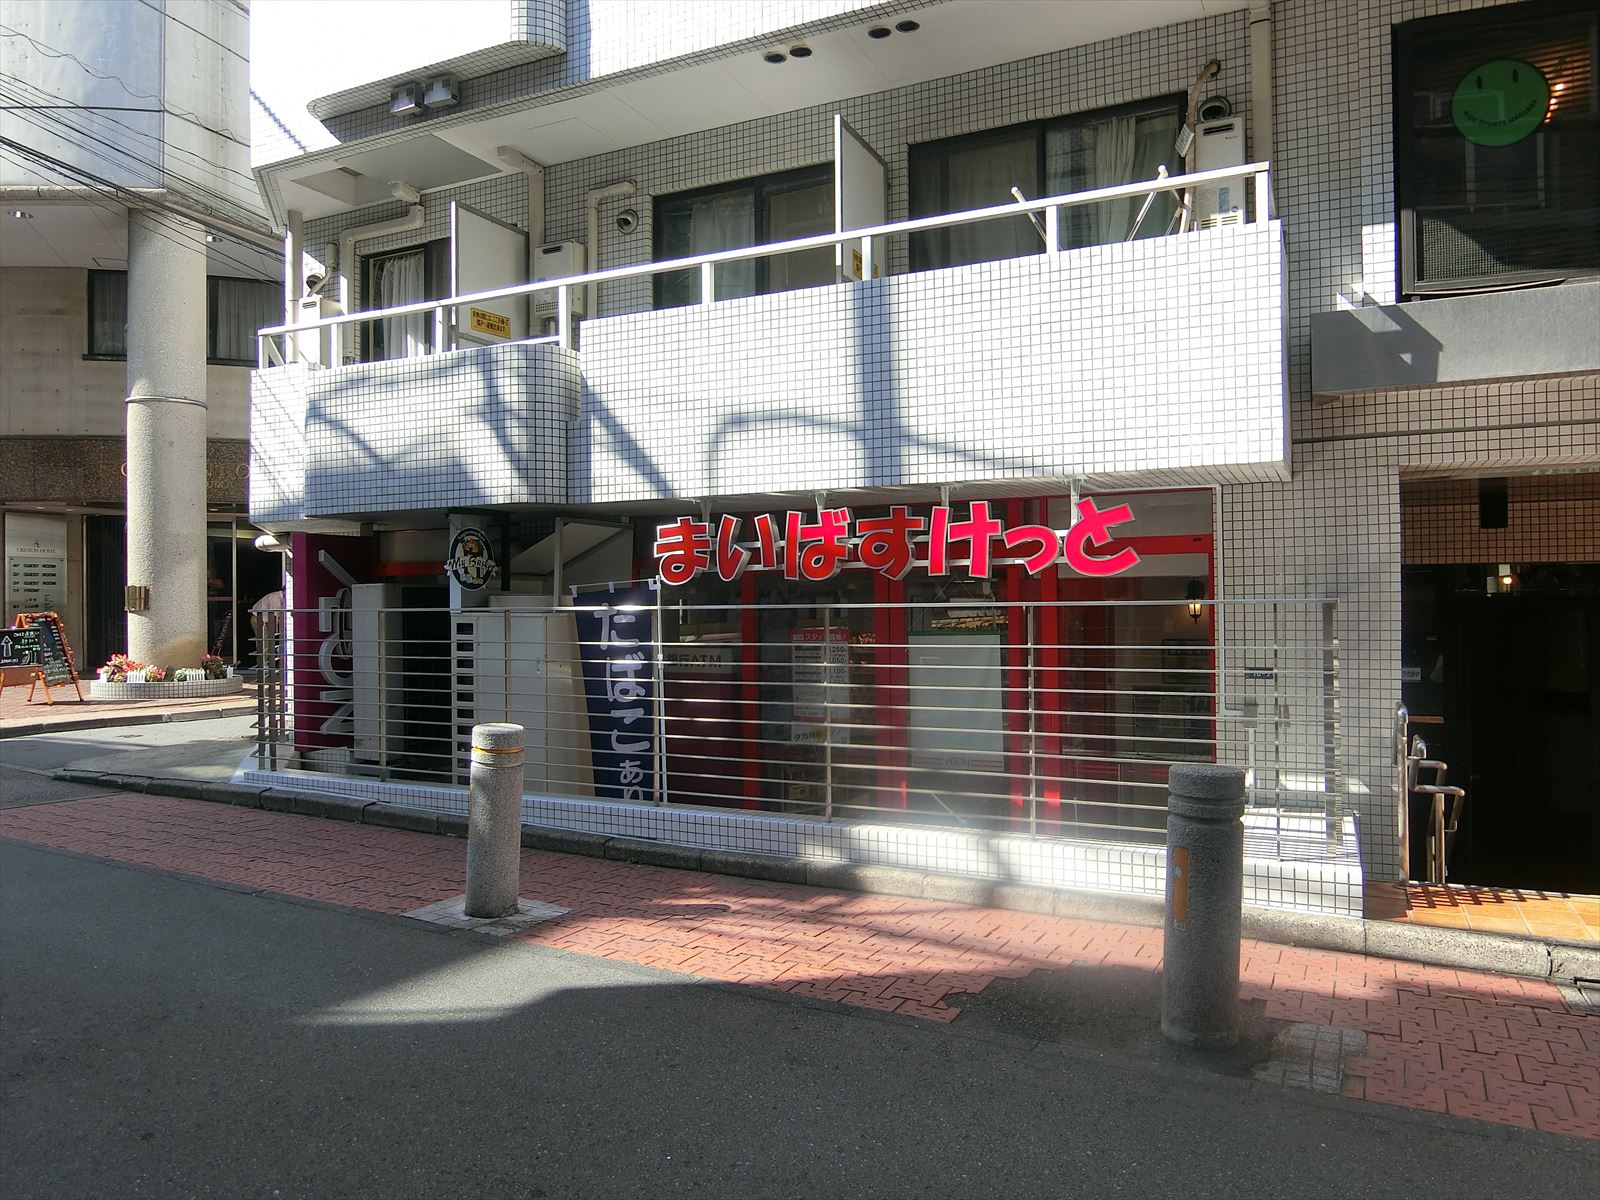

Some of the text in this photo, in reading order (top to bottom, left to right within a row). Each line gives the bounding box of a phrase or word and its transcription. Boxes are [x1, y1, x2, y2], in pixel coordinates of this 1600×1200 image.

[653, 496, 1142, 585] まいばすけっと
